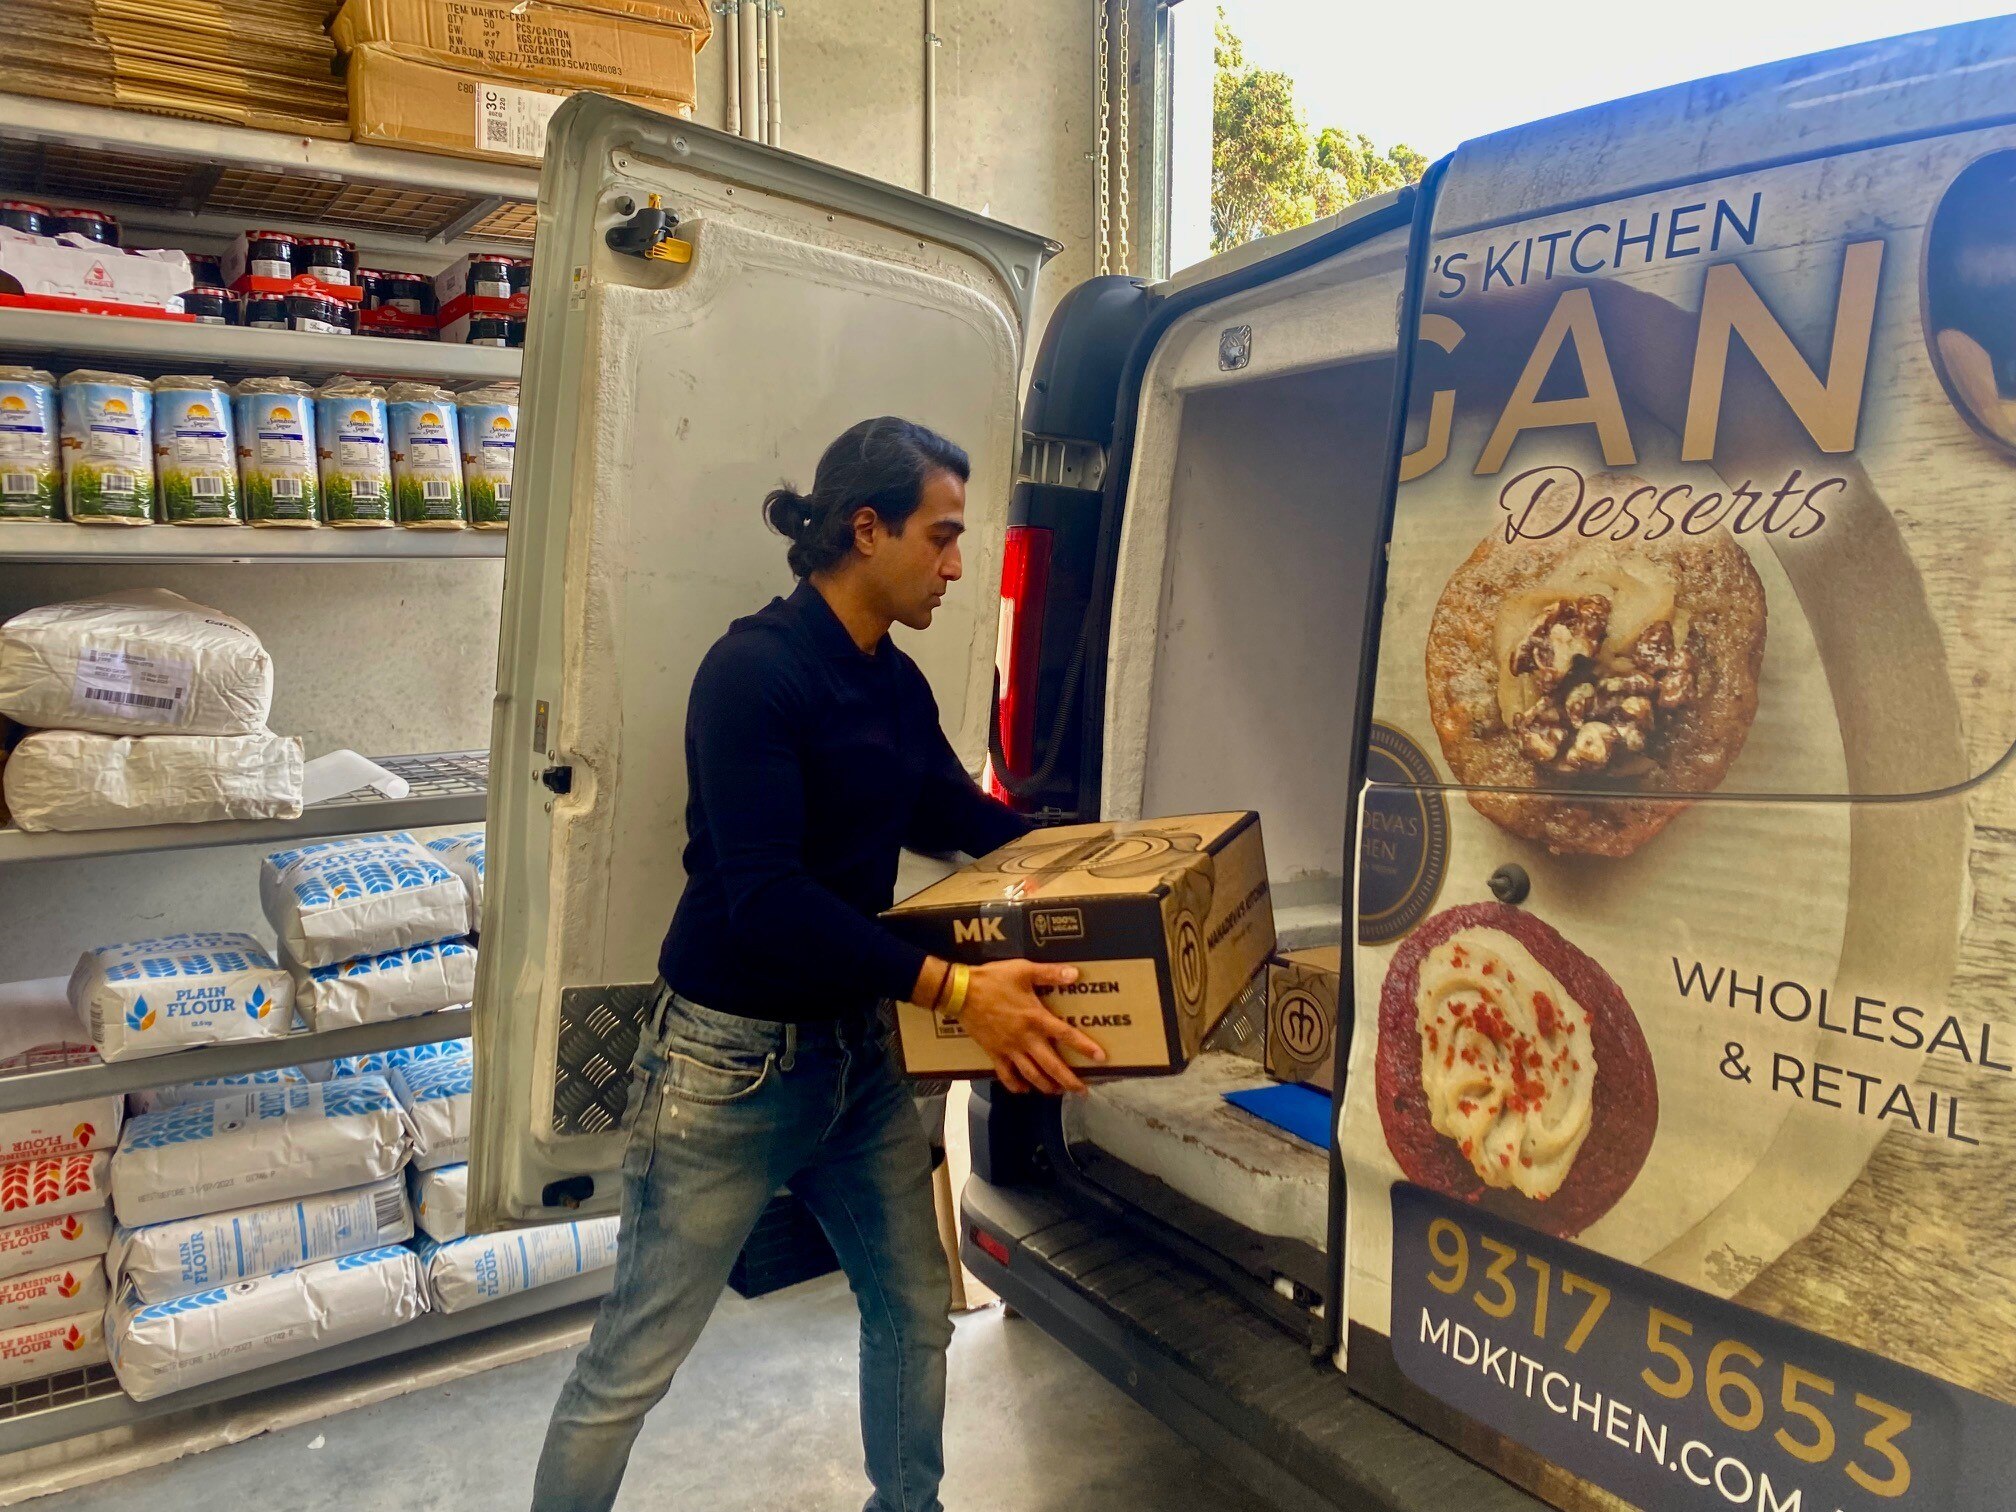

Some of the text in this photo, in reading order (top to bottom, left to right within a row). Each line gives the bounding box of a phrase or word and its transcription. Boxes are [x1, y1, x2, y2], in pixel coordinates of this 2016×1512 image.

[483, 18, 495, 29] 50
[516, 22, 570, 40] PCS/CARTON
[516, 33, 572, 49] KGS/CARTON
[517, 43, 573, 59] KGS/CARTON
[485, 91, 498, 111] 3C
[1481, 191, 1763, 292] KITCHEN
[1499, 464, 1848, 545] Desserts
[953, 916, 1007, 944] MK
[175, 985, 227, 1002] PLAIN
[1058, 981, 1120, 996] FROZEN
[166, 997, 237, 1018] FLOUR
[1080, 1013, 1132, 1027] CAKES
[1718, 1041, 1981, 1146] & RETAIL
[12, 1134, 62, 1152] FLOUR
[14, 1216, 63, 1238] RAISING
[0, 1230, 50, 1251] FLOUR
[179, 1241, 194, 1283] PLAIN
[190, 1230, 208, 1286] FLOUR
[474, 1257, 486, 1294] PLAIN
[484, 1247, 499, 1297] FLOUR
[12, 1274, 61, 1292] RAISING
[0, 1286, 48, 1306] FLOUR
[17, 1327, 66, 1346] RAISING
[3, 1340, 52, 1360] FLOUR
[1425, 1217, 1915, 1500] 9317 5653
[1418, 1306, 1803, 1512] MDKITCHEN.COM
